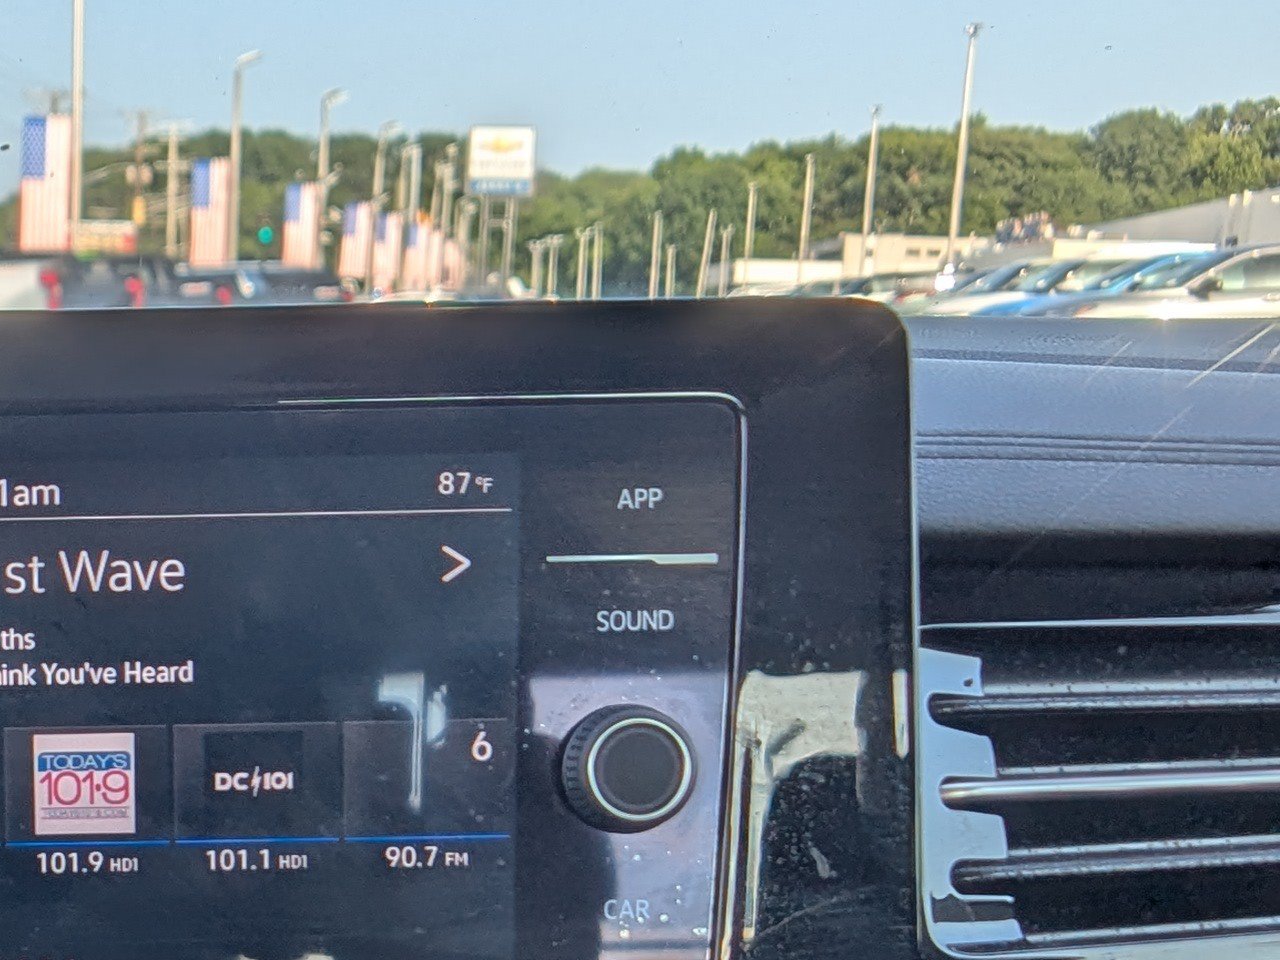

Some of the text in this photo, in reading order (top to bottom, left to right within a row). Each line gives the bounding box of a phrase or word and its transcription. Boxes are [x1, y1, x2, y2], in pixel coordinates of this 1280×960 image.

[617, 487, 664, 510] APP
[57, 549, 186, 593] Wave
[596, 608, 675, 632] SOUND
[41, 661, 118, 686] You've
[123, 659, 195, 684] Heard
[470, 730, 493, 763] 6
[36, 851, 139, 874] 101.9 HD1
[205, 848, 308, 871] 101.1 HD1
[384, 845, 470, 868] 90.7 FM
[603, 899, 650, 920] CAR
